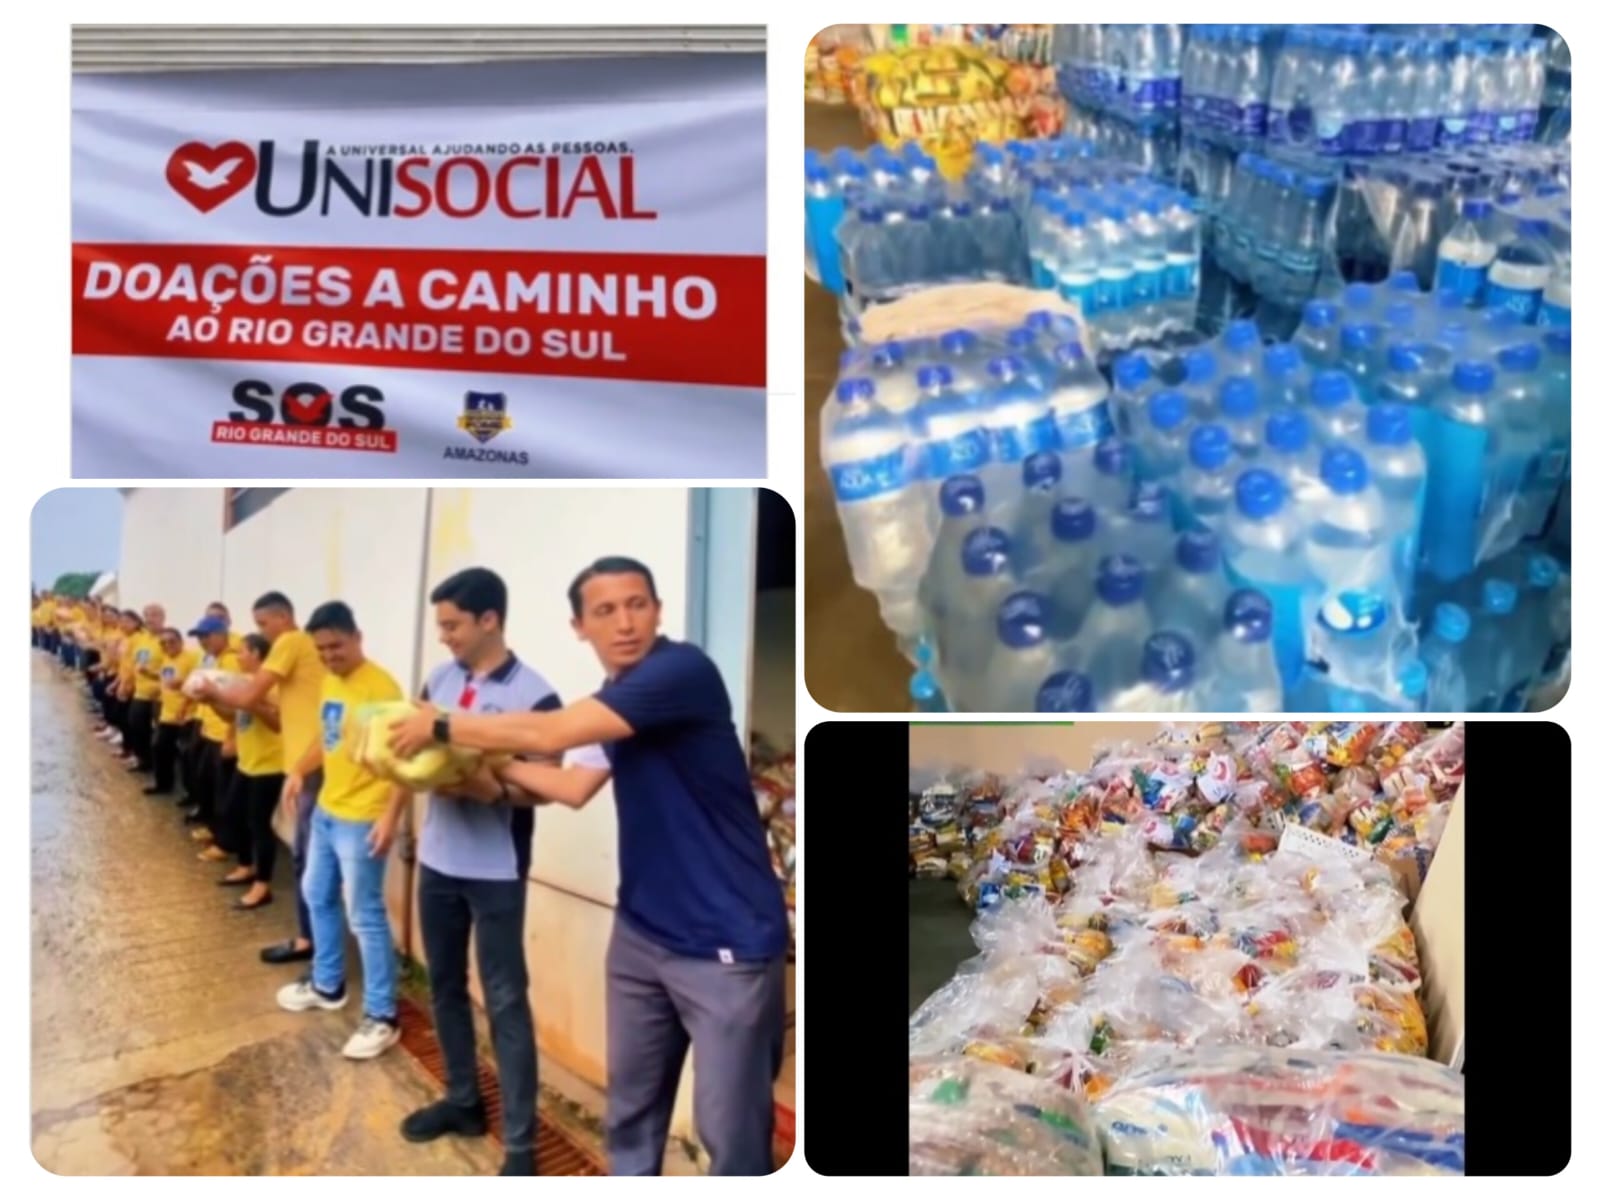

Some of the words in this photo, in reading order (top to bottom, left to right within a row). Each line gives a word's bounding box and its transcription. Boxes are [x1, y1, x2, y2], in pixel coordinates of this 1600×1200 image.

[325, 144, 337, 156] A
[340, 144, 427, 156] UNIVERSAL
[432, 143, 520, 155] AJUDANDO
[524, 142, 545, 153] AS
[552, 141, 633, 153] PESSOAS.
[83, 254, 352, 314] DOAÇÕES
[363, 267, 405, 308] A
[418, 268, 718, 320] CAMINHO
[166, 315, 220, 343] AO
[227, 317, 294, 346] RIO
[302, 319, 464, 353] GRANDE
[474, 325, 532, 356] DO
[541, 328, 627, 361] SUL
[228, 379, 386, 430] SOS
[216, 425, 246, 441] RIO
[249, 427, 322, 446] GRANDE
[325, 432, 351, 446] DO
[354, 434, 391, 449] SUL
[443, 446, 529, 466] AMAZONAS
